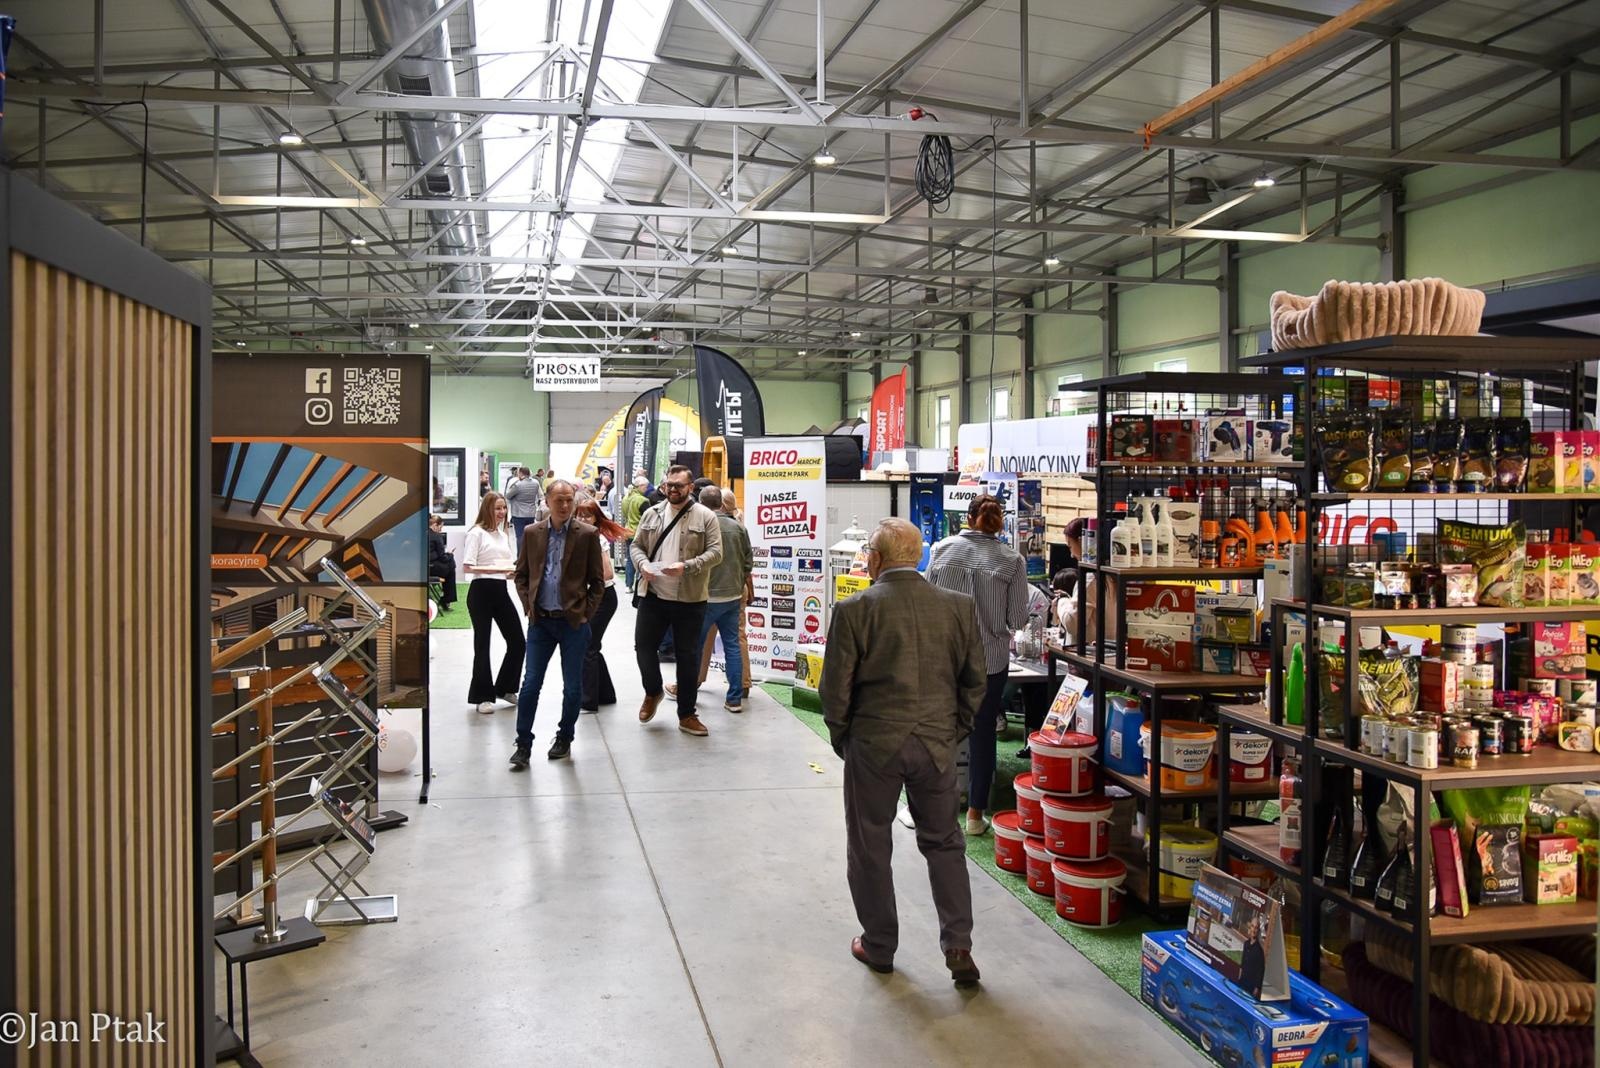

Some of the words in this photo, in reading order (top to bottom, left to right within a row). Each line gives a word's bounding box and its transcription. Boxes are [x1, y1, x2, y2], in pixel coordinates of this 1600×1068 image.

[537, 363, 599, 375] PROSAT
[749, 450, 798, 466] BRICO
[794, 470, 809, 478] PARK
[764, 491, 798, 503] NASZE
[949, 491, 978, 501] LAVOR
[760, 504, 805, 522] CENY
[1443, 524, 1513, 542] PREMIUM
[212, 555, 259, 568] koracyjne
[772, 559, 793, 571] KNAUF
[773, 574, 788, 582] YATO
[773, 585, 794, 593] HARDY
[772, 631, 794, 642] Bradas
[748, 644, 767, 653] ERRO
[751, 658, 768, 668] stway
[1277, 1030, 1306, 1043] DEDRA
